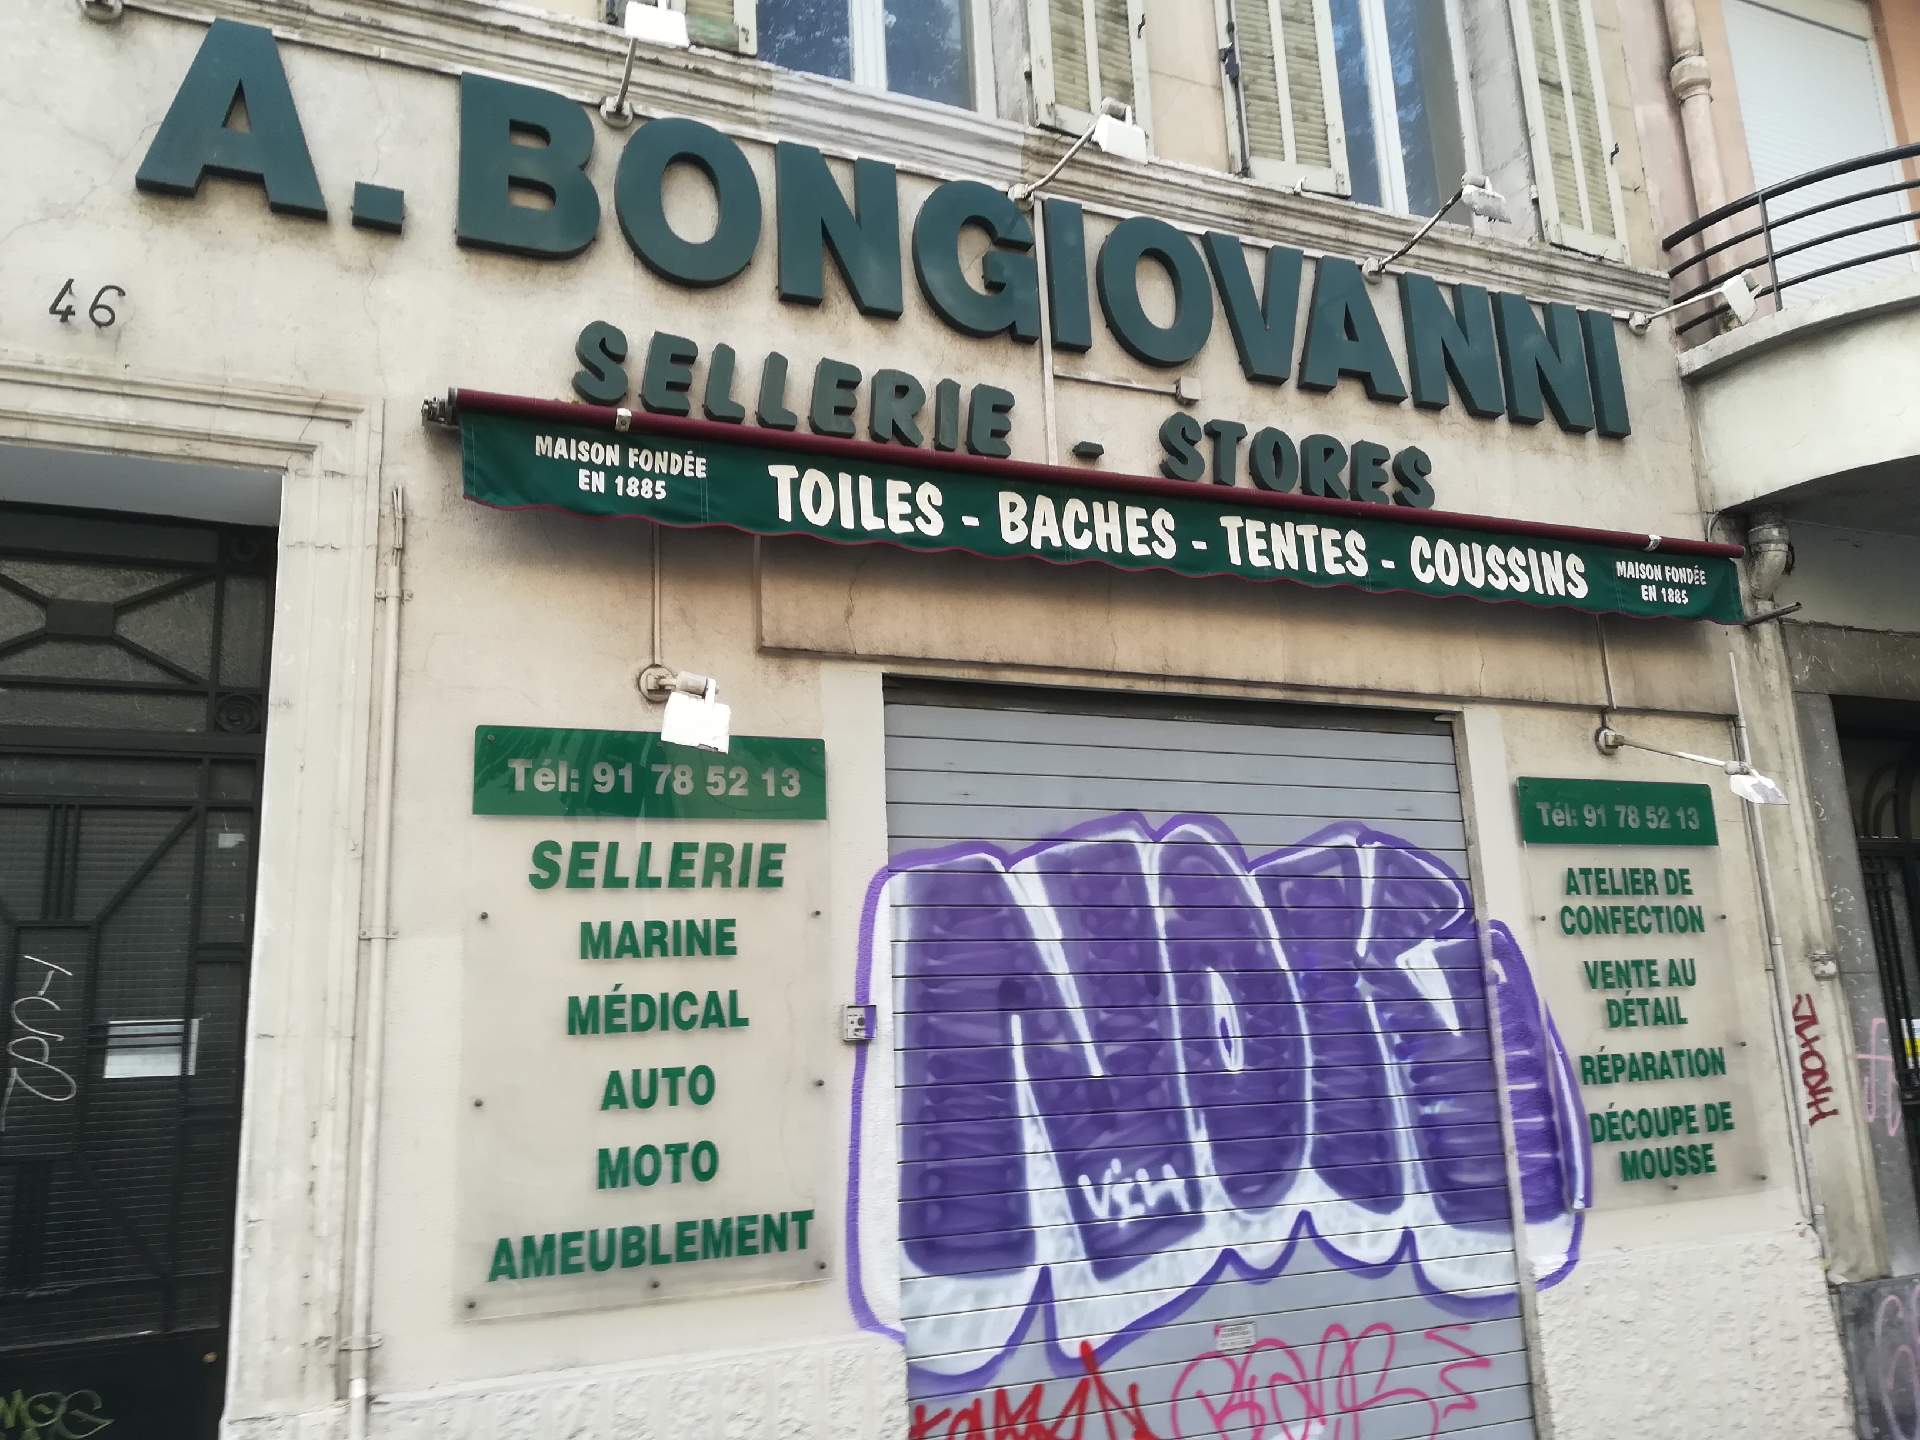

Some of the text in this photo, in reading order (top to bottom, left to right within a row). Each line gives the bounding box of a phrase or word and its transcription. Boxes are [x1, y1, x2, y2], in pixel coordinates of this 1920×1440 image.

[456, 71, 1632, 439] BONGIOVANNI
[48, 278, 126, 327] 46
[572, 320, 1016, 458] SELLERIE
[1159, 411, 1436, 509] STORES
[535, 435, 707, 478] MAISON FONDÉE
[578, 468, 667, 500] EN 1885
[768, 464, 944, 536] TOILES
[1000, 491, 1176, 560] BACHES
[1219, 515, 1369, 577] TENTES
[1410, 535, 1589, 600] COUSSINS
[1616, 561, 1707, 586] MAISON FONDÉE
[1641, 584, 1688, 605] EN 1885
[508, 758, 800, 797] Tél: 91 78 52 13
[1536, 801, 1700, 830] Tél: 91 78 52 13
[528, 840, 787, 890] SELLERIE
[1566, 867, 1694, 896] ATELIER DE
[580, 918, 738, 960] MARINE
[1560, 905, 1706, 935] CONFECTION
[1584, 958, 1697, 990] VENTE AU
[567, 983, 749, 1036] MÉDICAL
[1607, 990, 1689, 1029] DÉTAIL
[1580, 1045, 1726, 1086] RÉPARATION
[600, 1065, 716, 1111] AUTO
[1591, 1101, 1736, 1144] DÉCOUPE DE
[596, 1140, 719, 1190] MOTO
[1621, 1143, 1718, 1182] MOUSSE
[488, 1209, 815, 1282] AMEUBLEMENT
